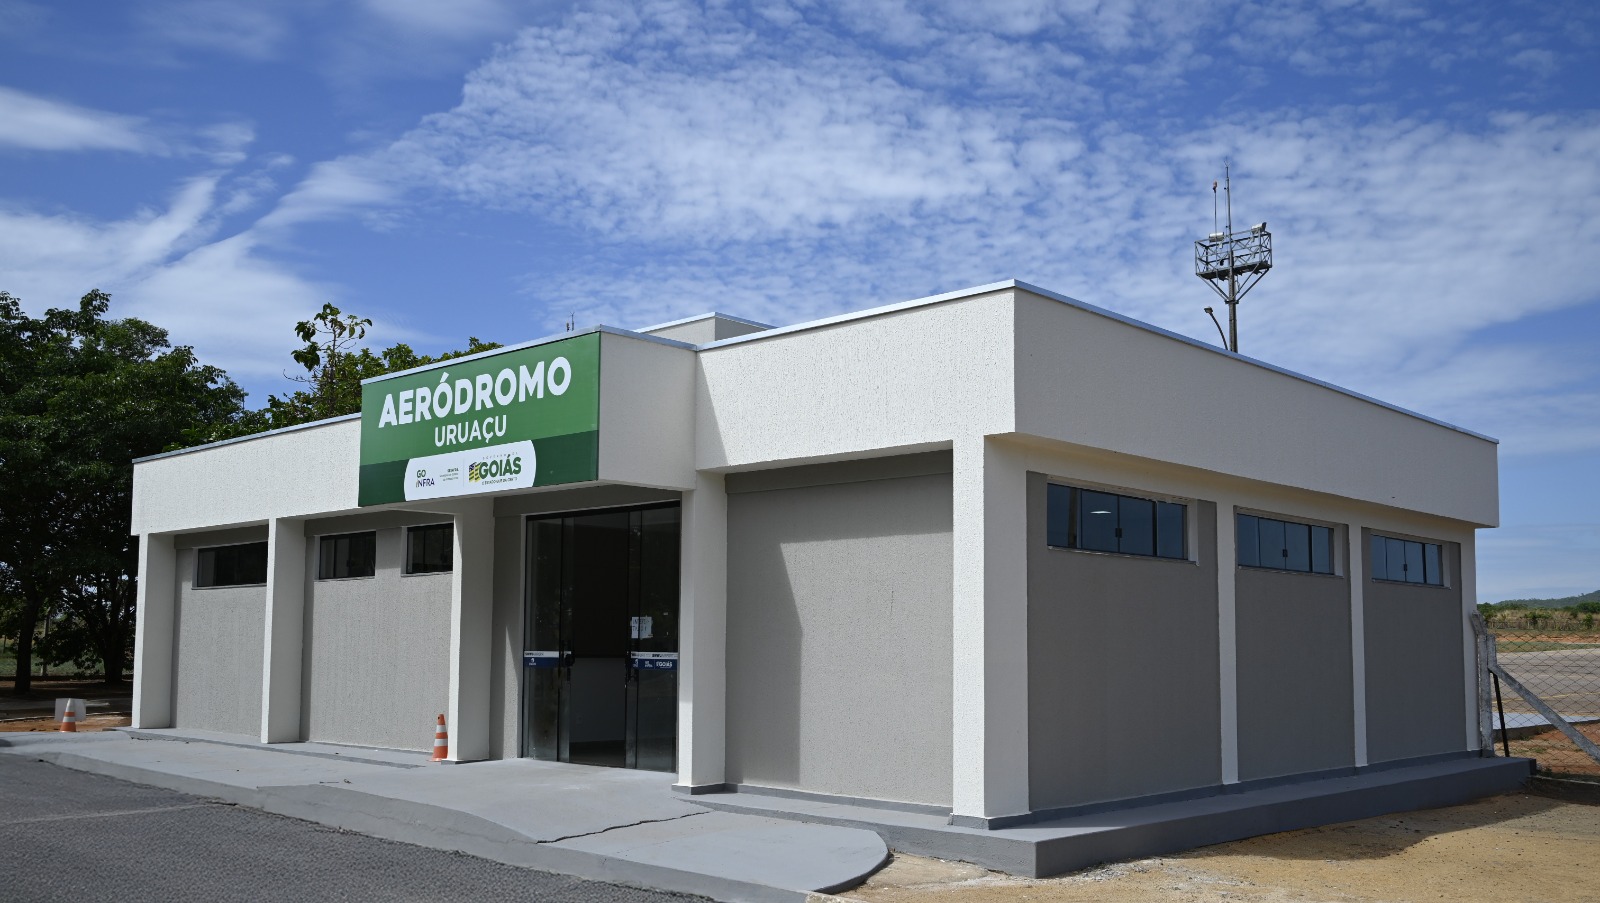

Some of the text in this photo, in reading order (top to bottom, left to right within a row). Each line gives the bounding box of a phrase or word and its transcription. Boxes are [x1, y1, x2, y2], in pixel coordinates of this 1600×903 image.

[378, 356, 572, 428] AERÓDROMO
[434, 414, 507, 447] URUAÇU
[416, 469, 427, 478] GO
[479, 454, 522, 479] GOIÁS
